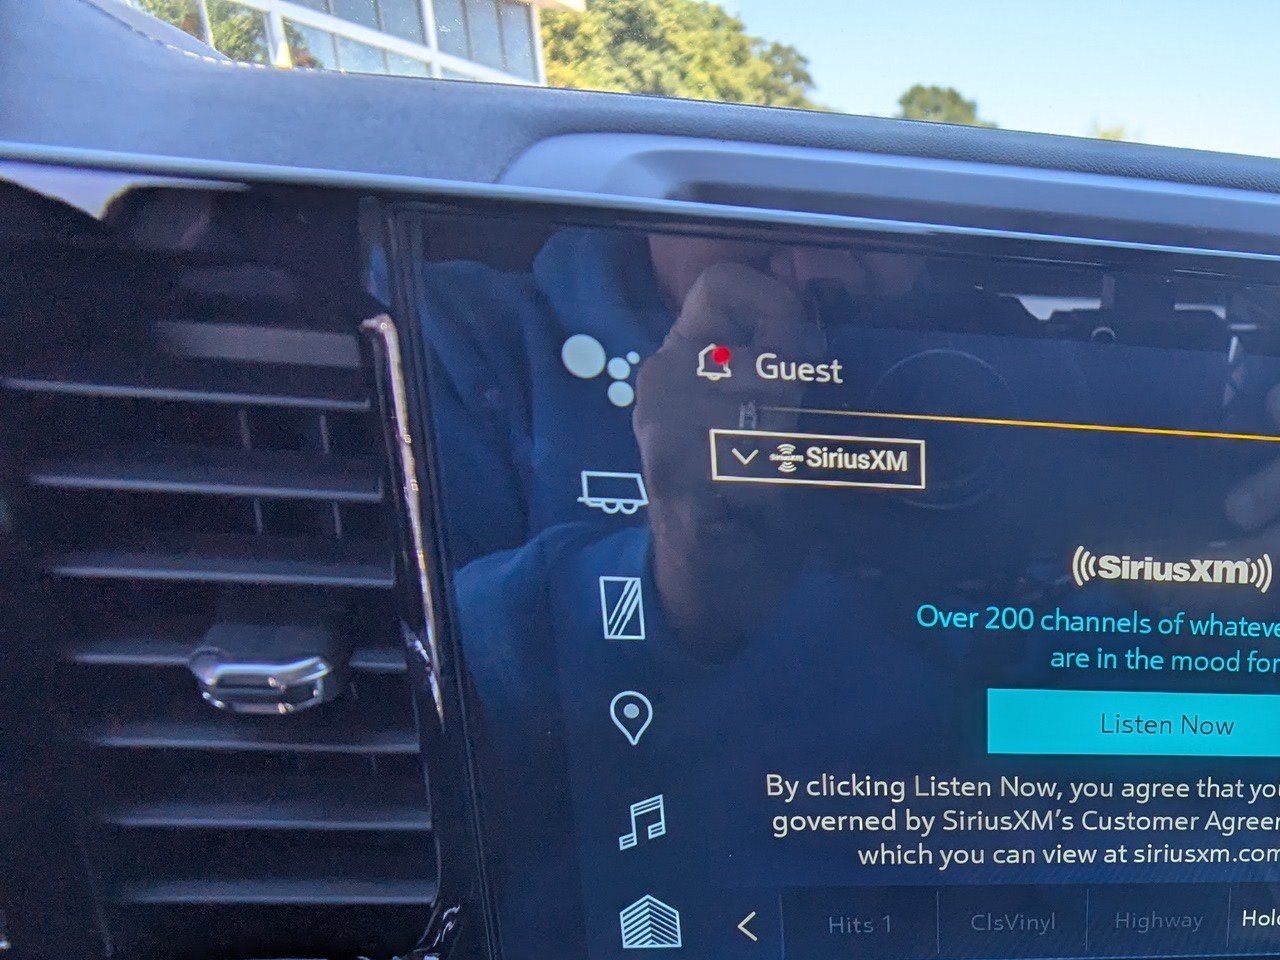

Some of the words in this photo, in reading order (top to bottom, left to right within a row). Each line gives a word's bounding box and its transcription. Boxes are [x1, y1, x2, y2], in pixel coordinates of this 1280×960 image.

[756, 352, 843, 384] Guest
[806, 446, 908, 472] SiriusXM
[916, 604, 979, 629] Over
[985, 607, 1034, 631] 200
[1041, 609, 1151, 636] channels
[1158, 611, 1184, 636] of
[1051, 650, 1090, 669] are
[1097, 647, 1118, 669] in
[1125, 648, 1164, 671] the
[1171, 650, 1241, 672] mood
[1101, 712, 1173, 735] Listen
[1180, 714, 1235, 736] Now
[766, 774, 799, 802] By
[806, 774, 905, 803] clicking
[914, 775, 991, 798] Listen
[1000, 776, 1062, 801] Now,
[1070, 781, 1112, 803] you
[1121, 781, 1189, 804] agree
[1197, 777, 1244, 799] that
[772, 808, 896, 837] governed
[905, 809, 935, 836] by
[1081, 810, 1199, 831] Customer
[858, 844, 933, 865] which
[939, 848, 985, 870] you
[993, 847, 1035, 864] can
[1042, 844, 1098, 864] view
[1103, 845, 1128, 863] at
[828, 915, 875, 935] Hits
[883, 915, 892, 933] 1
[970, 912, 1056, 936] ClsVinyl
[1115, 911, 1204, 935] Highway
